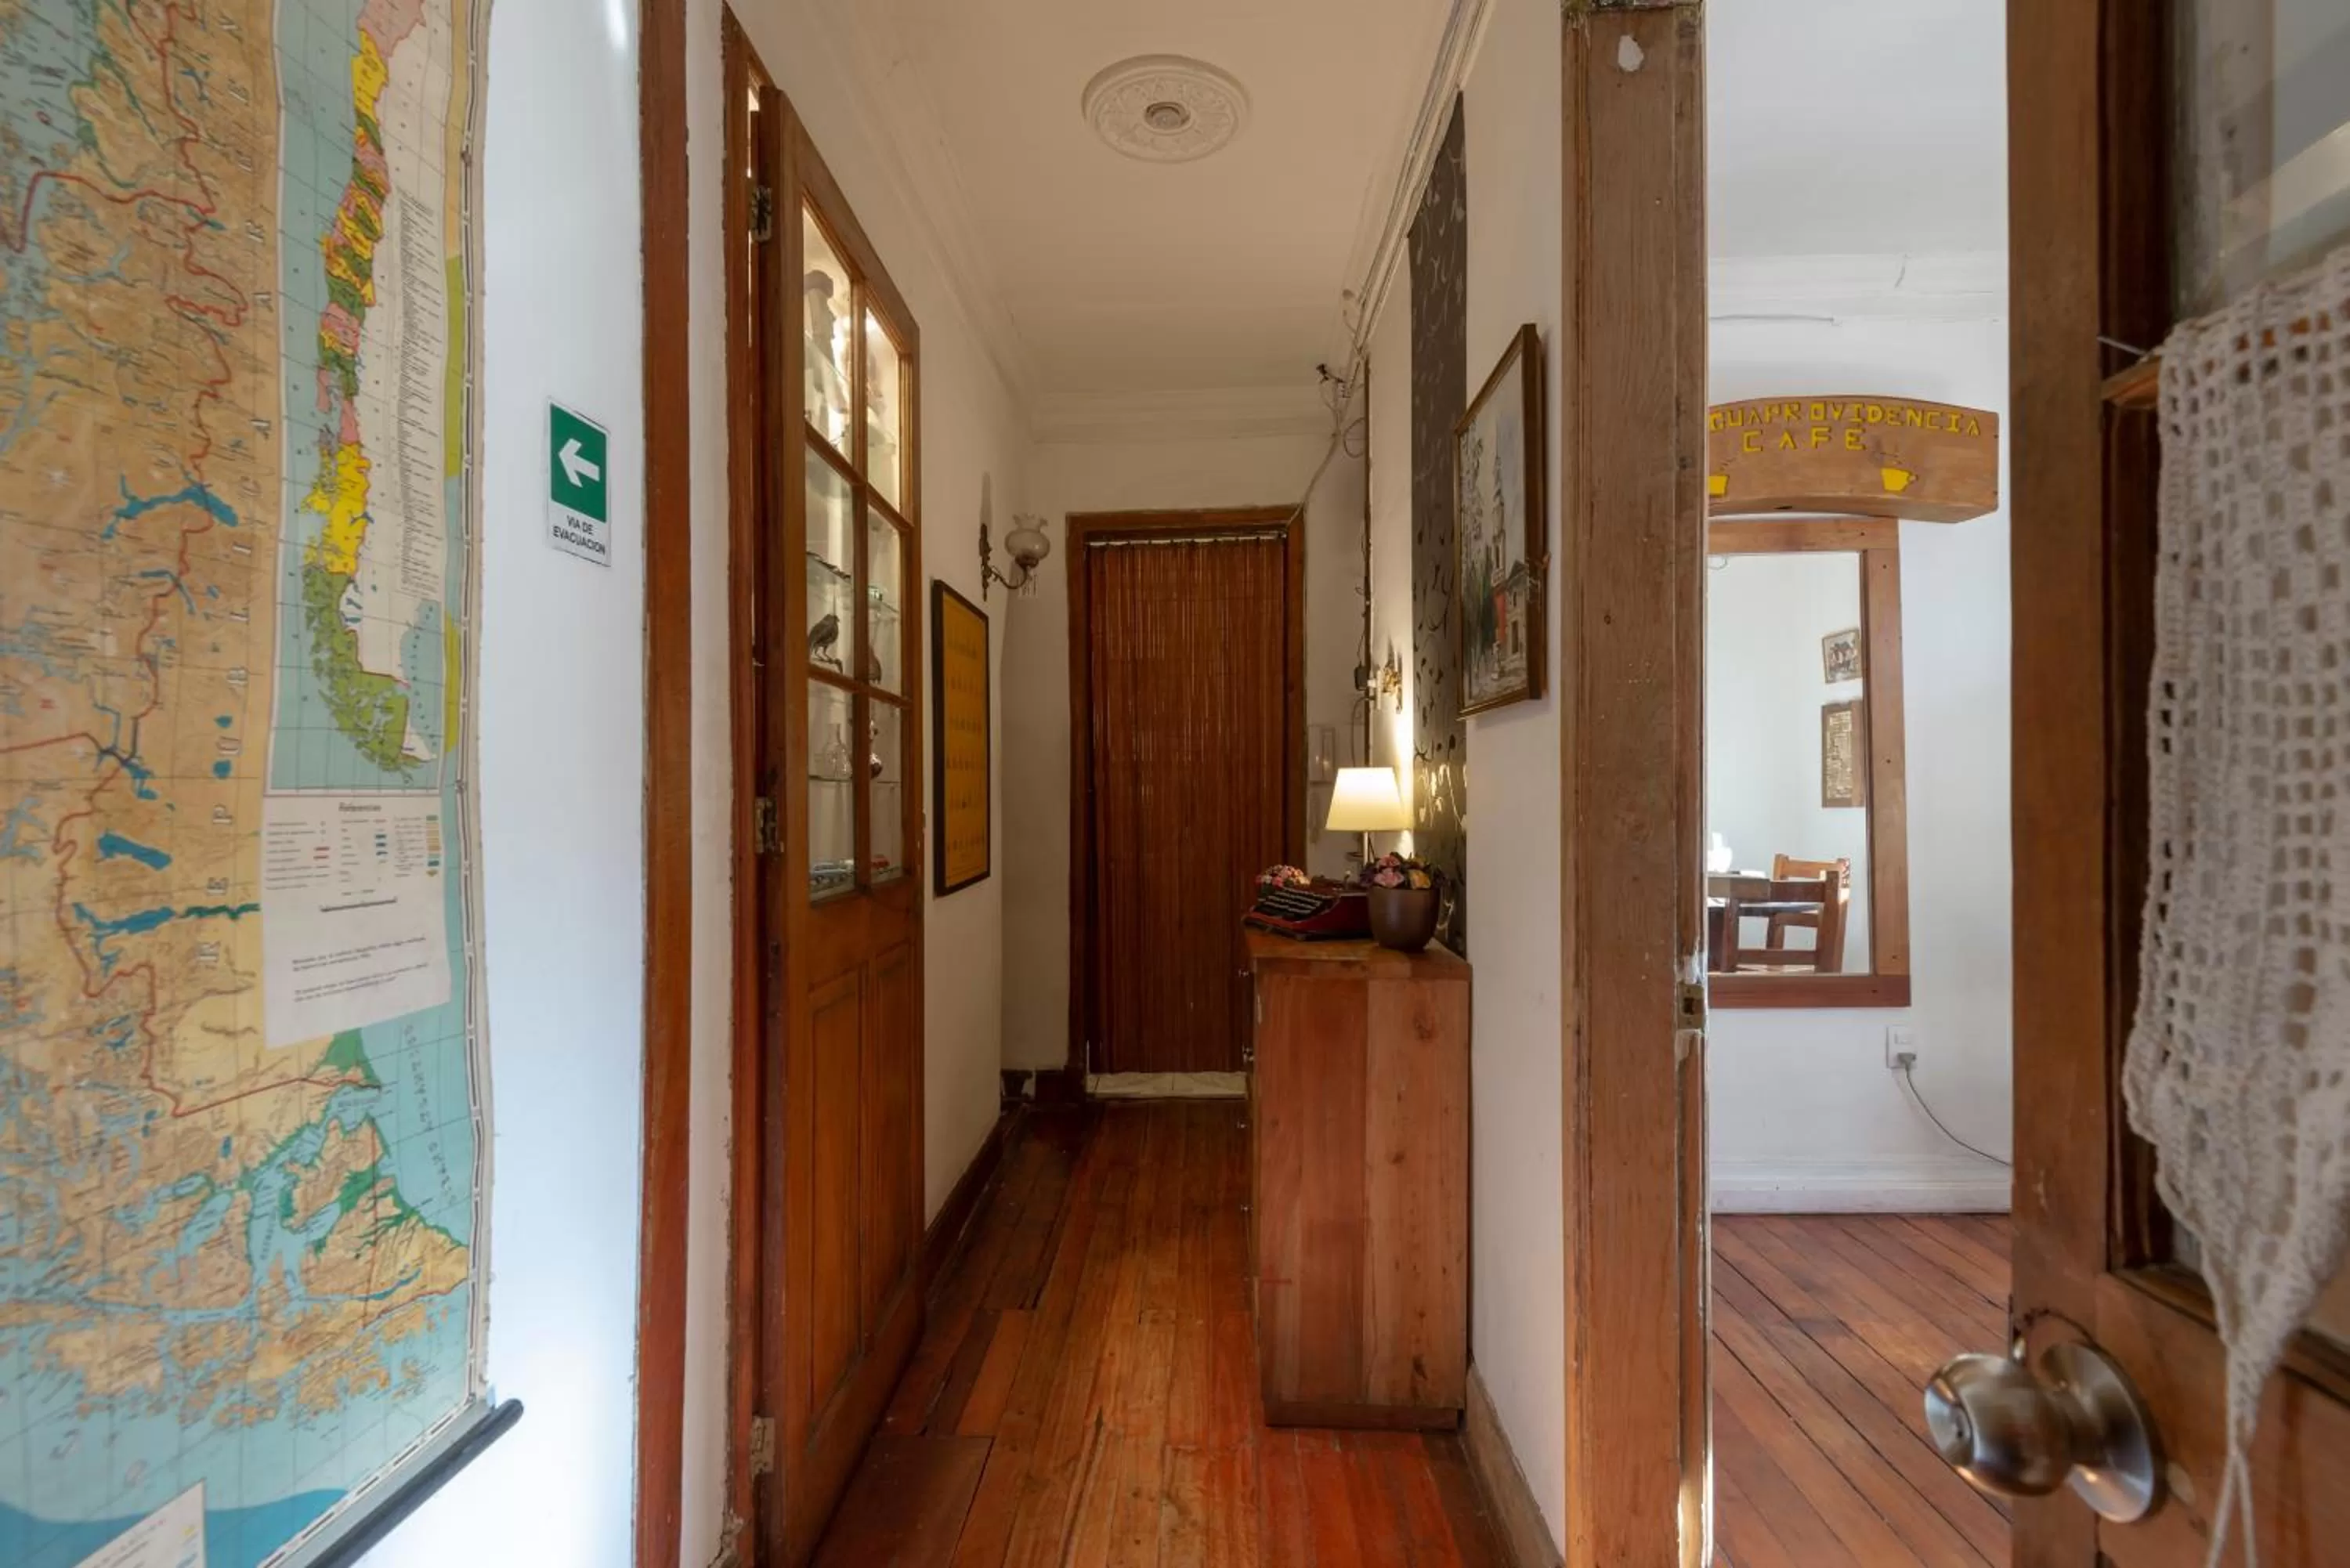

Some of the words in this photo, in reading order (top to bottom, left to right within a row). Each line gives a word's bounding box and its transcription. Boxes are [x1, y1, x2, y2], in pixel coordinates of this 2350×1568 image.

[1742, 426, 1867, 453] CAFE
[566, 515, 580, 529] VIA
[582, 522, 594, 536] DE
